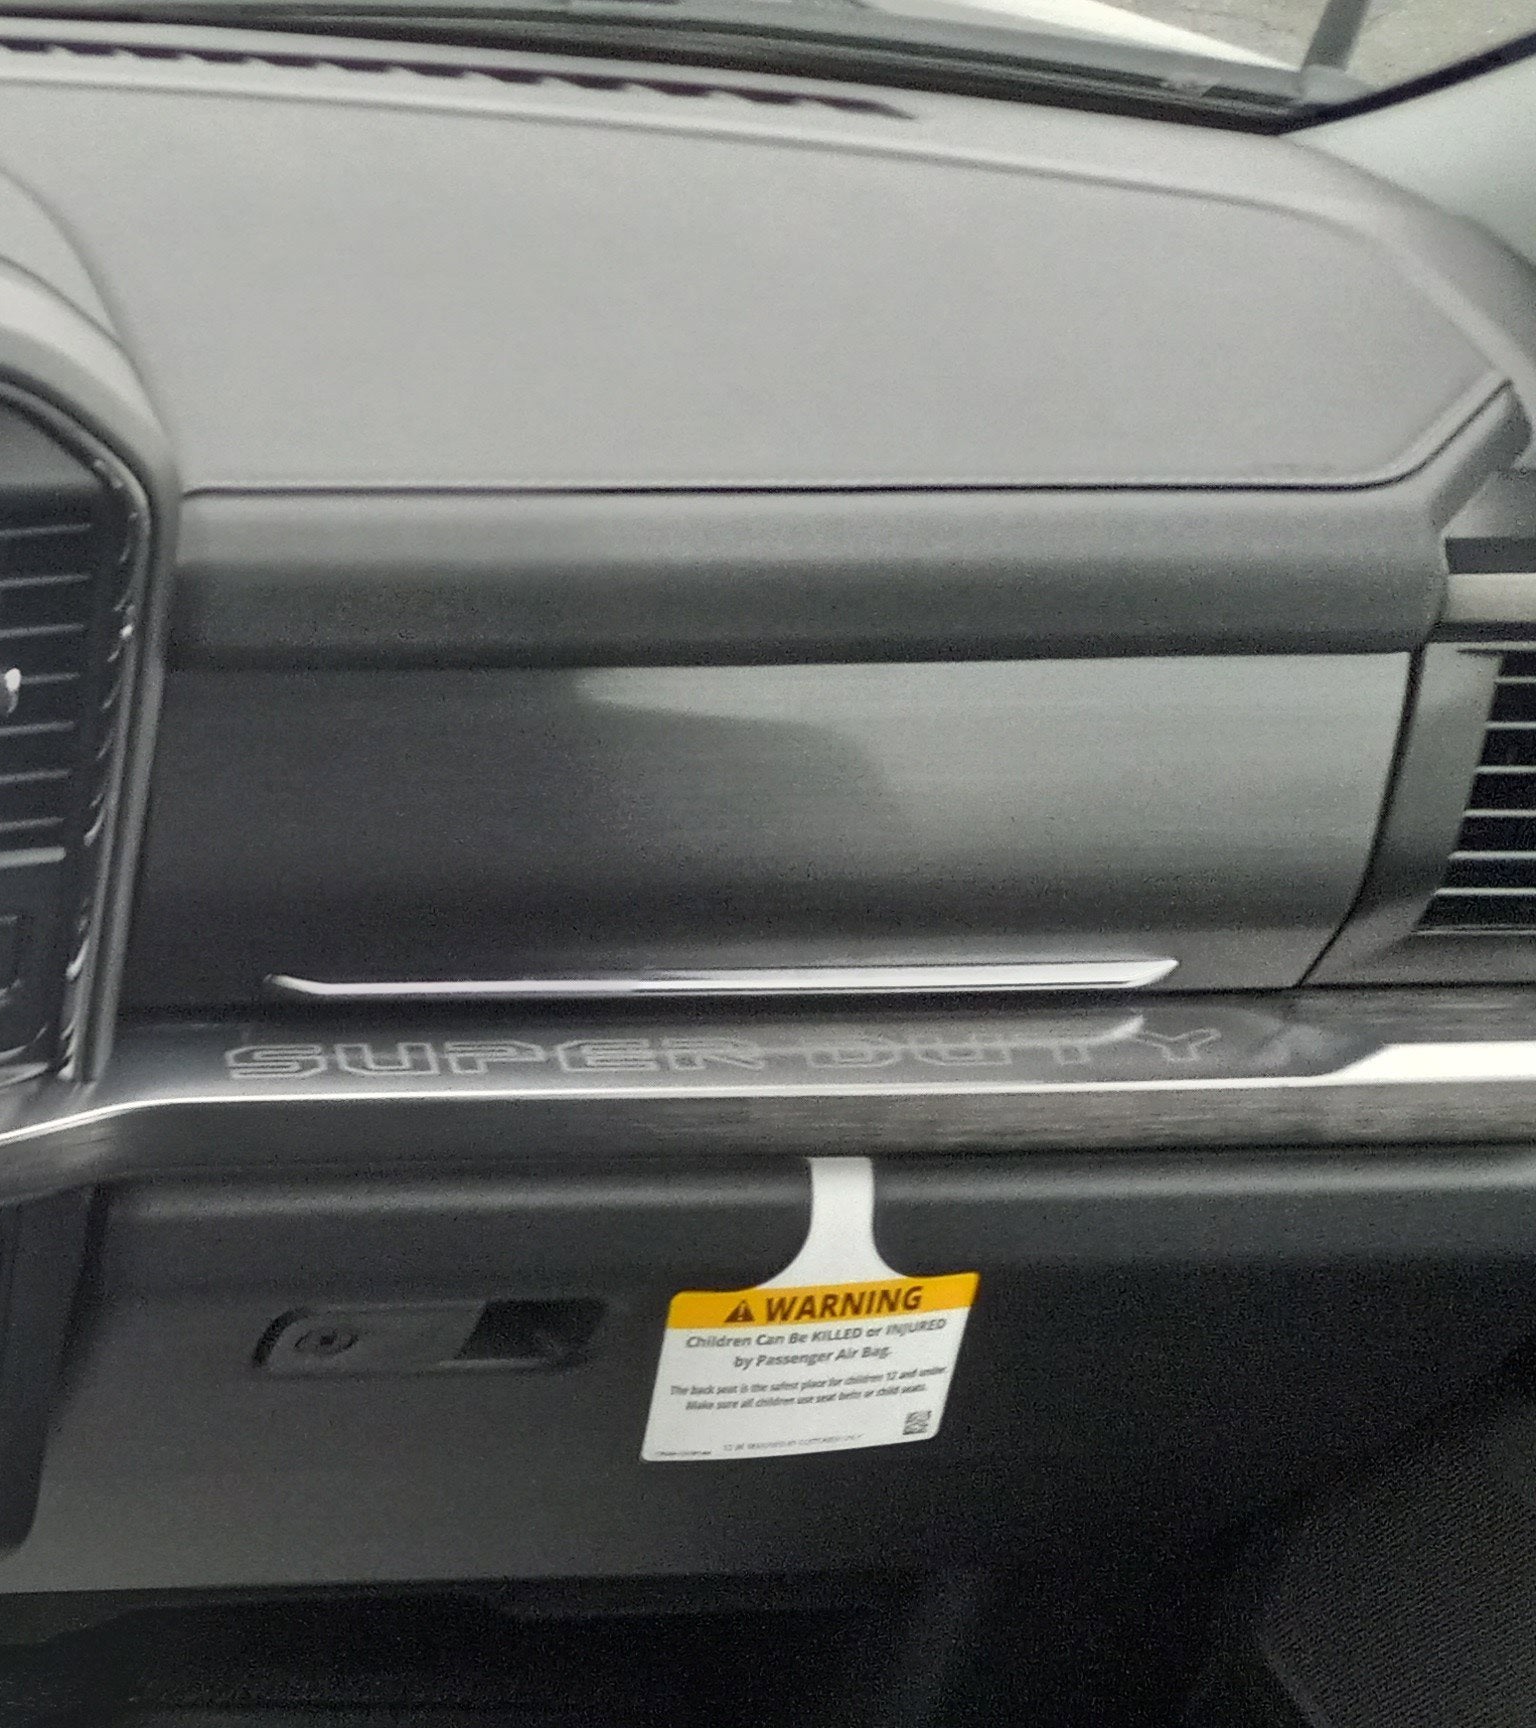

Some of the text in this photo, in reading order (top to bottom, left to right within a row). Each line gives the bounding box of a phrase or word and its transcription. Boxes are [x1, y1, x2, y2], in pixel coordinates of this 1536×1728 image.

[225, 1027, 1221, 1080] SUPER DUTY
[765, 1285, 925, 1323] WARNING
[685, 1318, 948, 1349] Children Can Be KILLED or INJURED
[733, 1354, 754, 1371] by
[755, 1351, 834, 1368] Passenger
[834, 1348, 859, 1362] Air
[669, 1384, 689, 1396] The
[690, 1384, 715, 1395] back
[685, 1400, 715, 1411] Make
